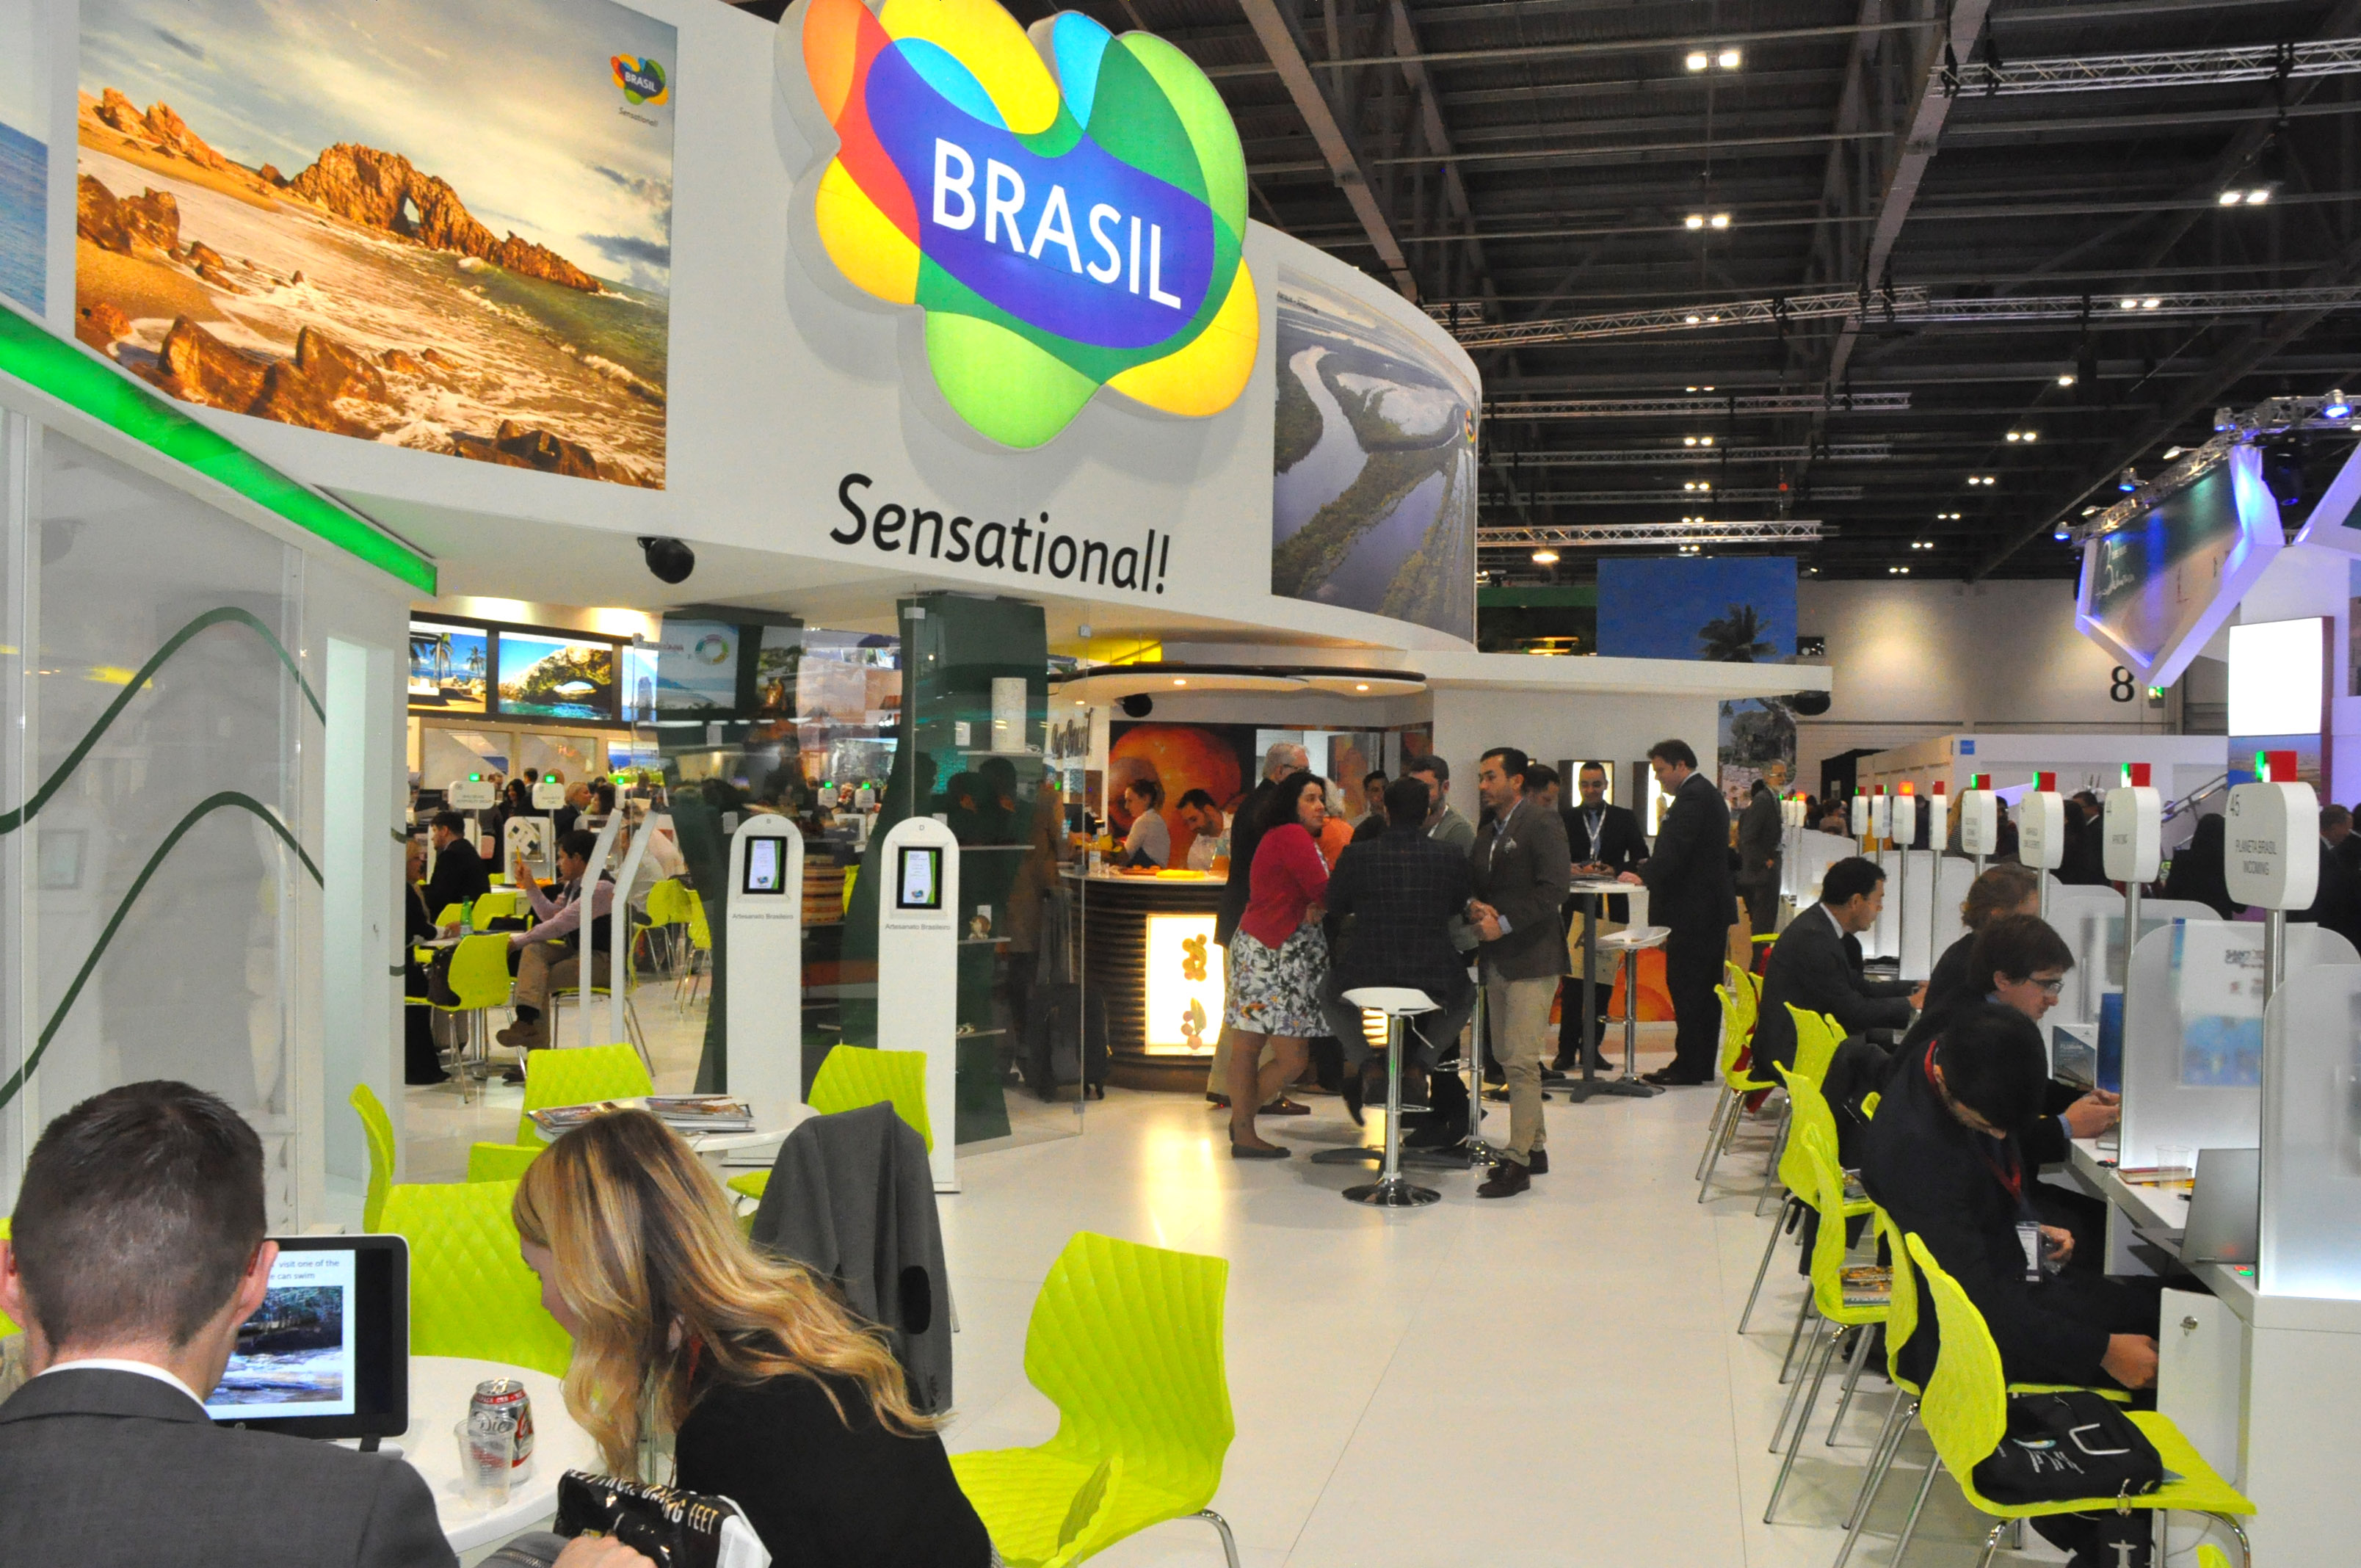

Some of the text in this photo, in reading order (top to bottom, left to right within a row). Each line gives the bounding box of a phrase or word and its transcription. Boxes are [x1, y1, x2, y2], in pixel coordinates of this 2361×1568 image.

[625, 71, 657, 92] BRASIL
[618, 106, 659, 128] Sensational!
[932, 137, 1181, 310] BRASIL
[829, 473, 1170, 595] Sensational!
[2111, 665, 2135, 703] 8
[2230, 794, 2240, 816] 45
[2235, 839, 2277, 855] PLANETA BRASIL
[2243, 860, 2269, 876] INCOMING
[687, 1502, 719, 1536] FEET
